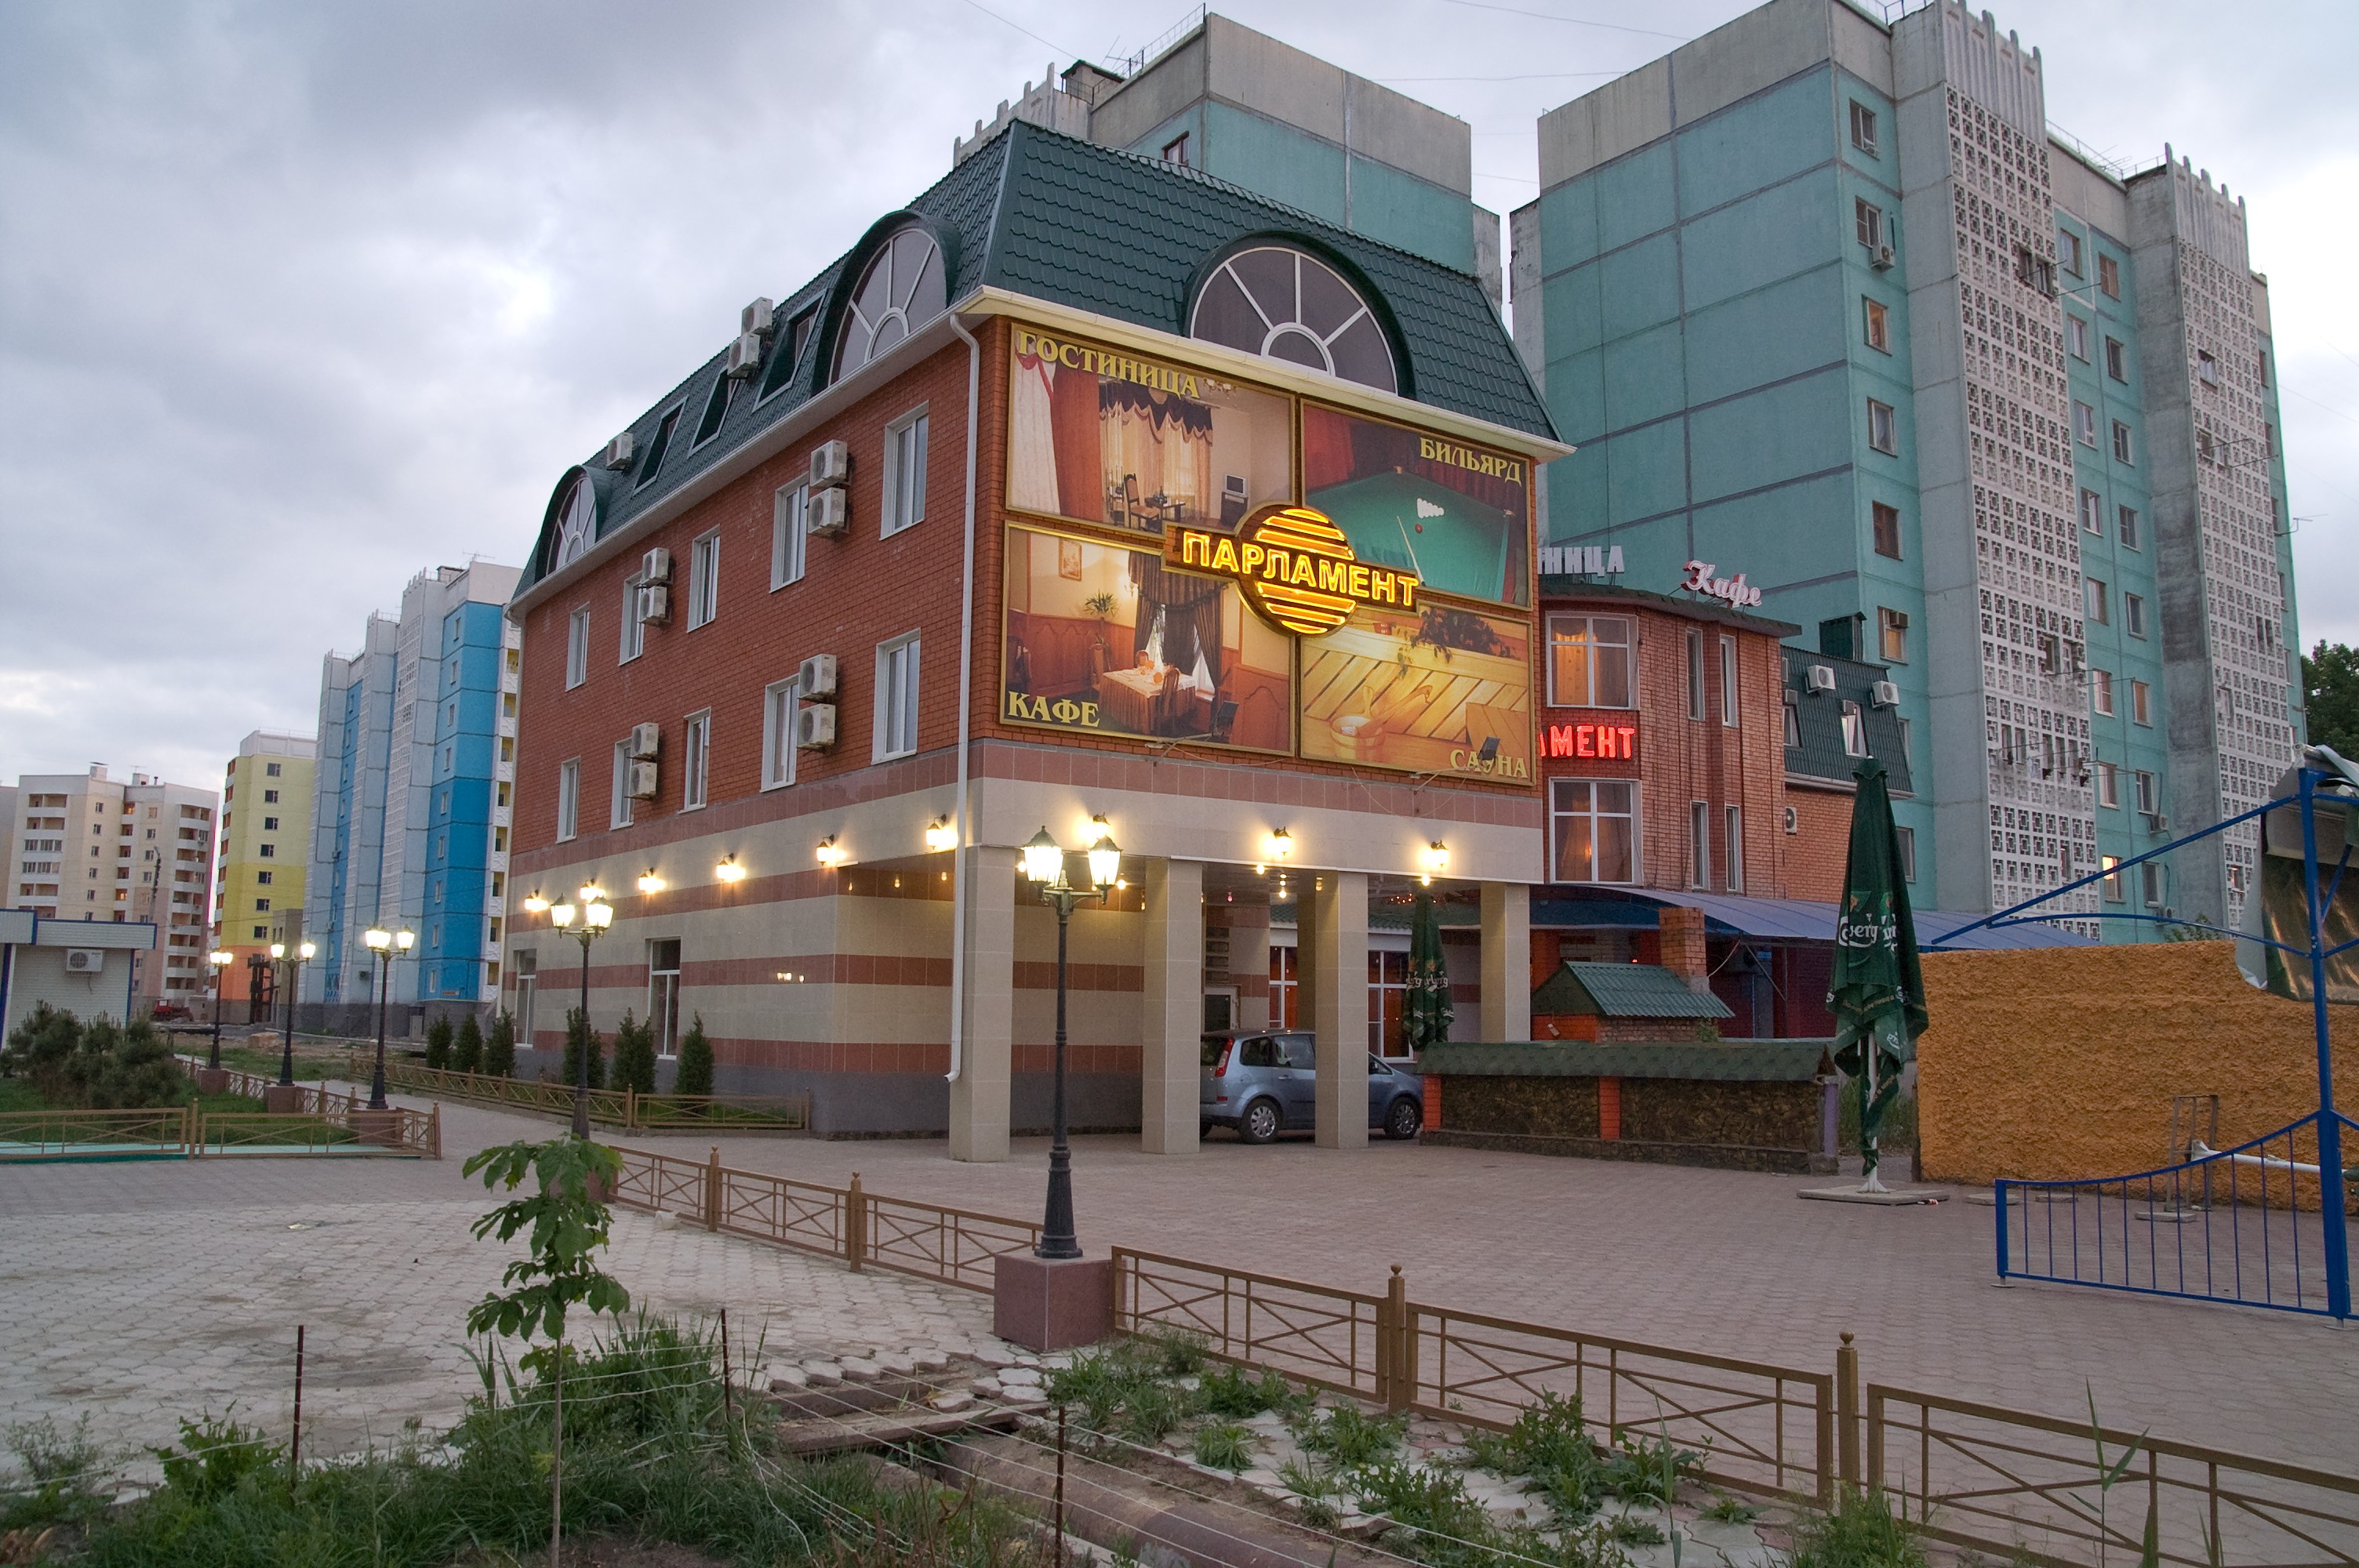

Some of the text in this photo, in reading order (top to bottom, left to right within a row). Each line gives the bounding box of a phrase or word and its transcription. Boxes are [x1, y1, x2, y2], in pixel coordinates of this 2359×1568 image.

[1019, 331, 1200, 400] ГОСТИНИЦА
[1420, 437, 1522, 488] БИЛЬЯРД
[1183, 530, 1419, 606] ПАРЛАМЕНТ
[1681, 560, 1762, 608] Кафе
[1008, 691, 1100, 728] КАФЕ
